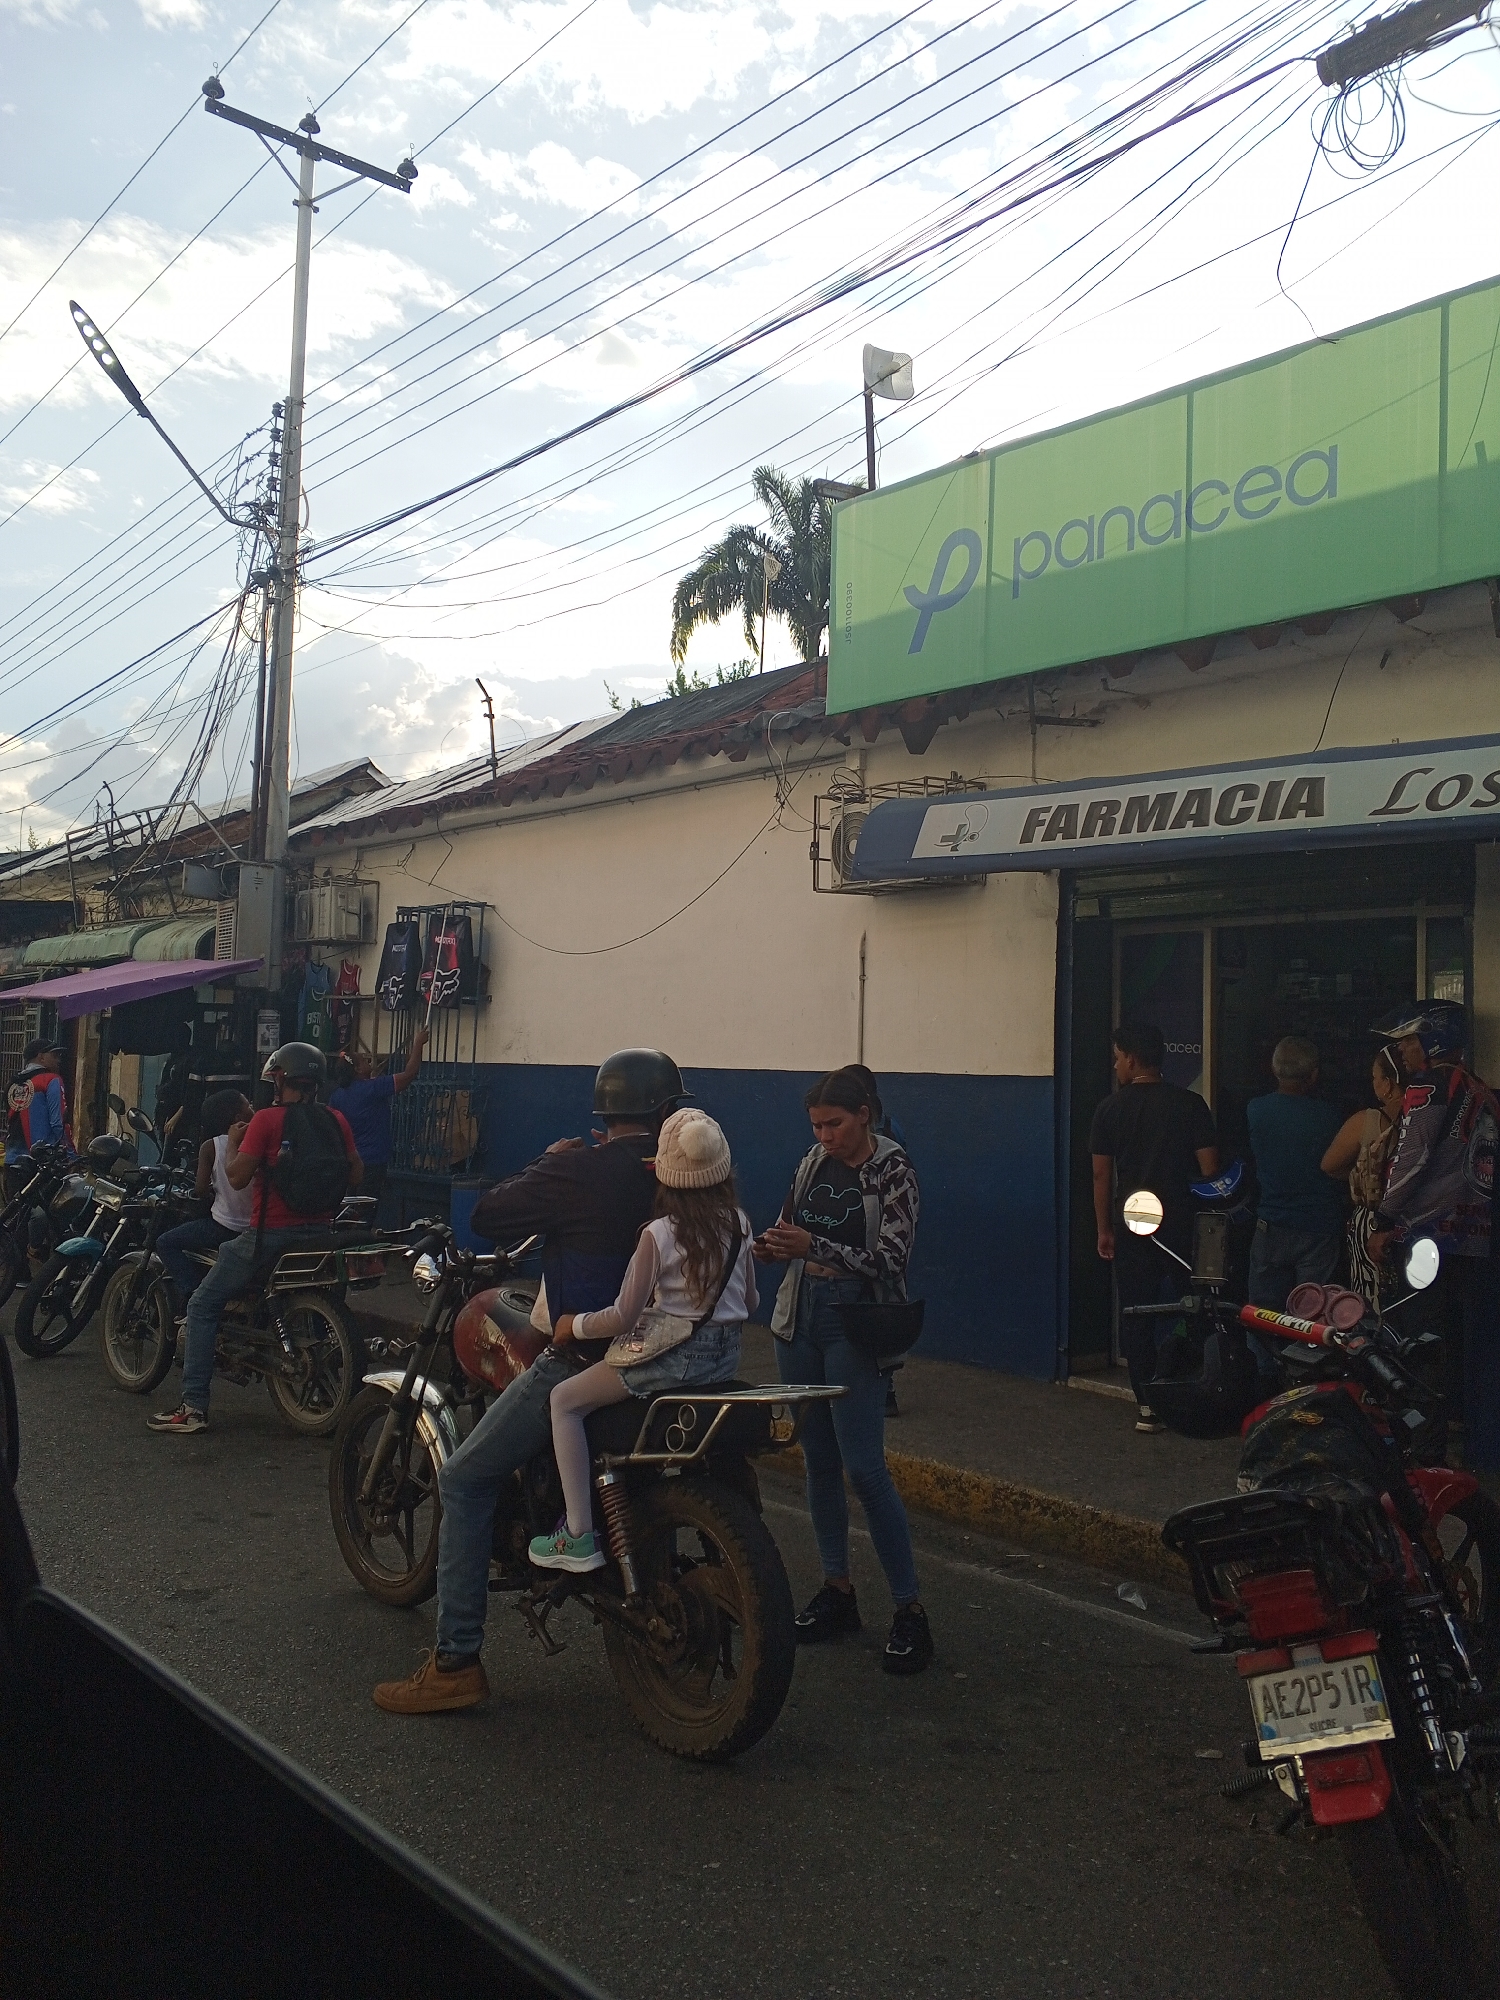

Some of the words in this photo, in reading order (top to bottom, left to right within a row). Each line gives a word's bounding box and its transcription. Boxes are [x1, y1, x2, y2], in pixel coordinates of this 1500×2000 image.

[1011, 444, 1340, 599] panacea
[1019, 776, 1325, 845] FARMACIA
[1261, 1664, 1376, 1722] AE2P51R
[1308, 1718, 1337, 1733] SUCRE
